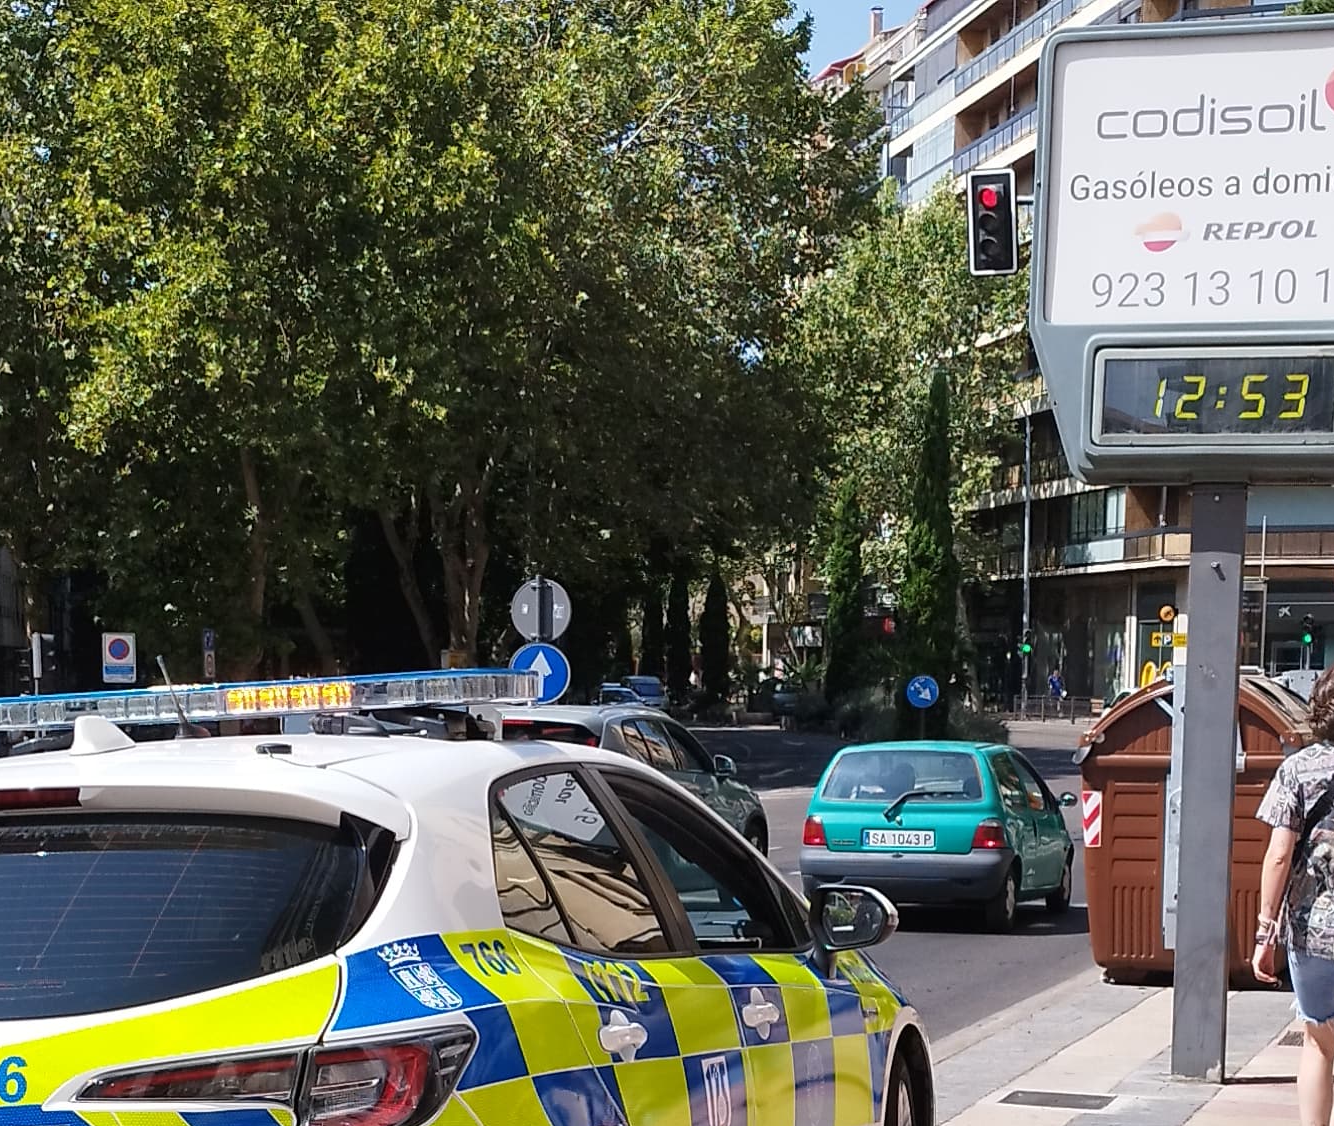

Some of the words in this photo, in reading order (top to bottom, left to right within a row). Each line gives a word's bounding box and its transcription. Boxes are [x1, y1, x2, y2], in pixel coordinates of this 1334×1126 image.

[1096, 88, 1326, 140] codisoil
[1069, 170, 1213, 201] Gasóleos
[1224, 175, 1240, 196] a
[1202, 219, 1318, 242] REPSOL
[1091, 271, 1166, 309] 923
[1184, 270, 1231, 306] 13
[1249, 268, 1297, 305] 10
[1154, 373, 1310, 420] 12:53
[871, 832, 887, 845] SA
[892, 832, 921, 846] 1043
[924, 832, 932, 846] P
[458, 939, 522, 977] 766
